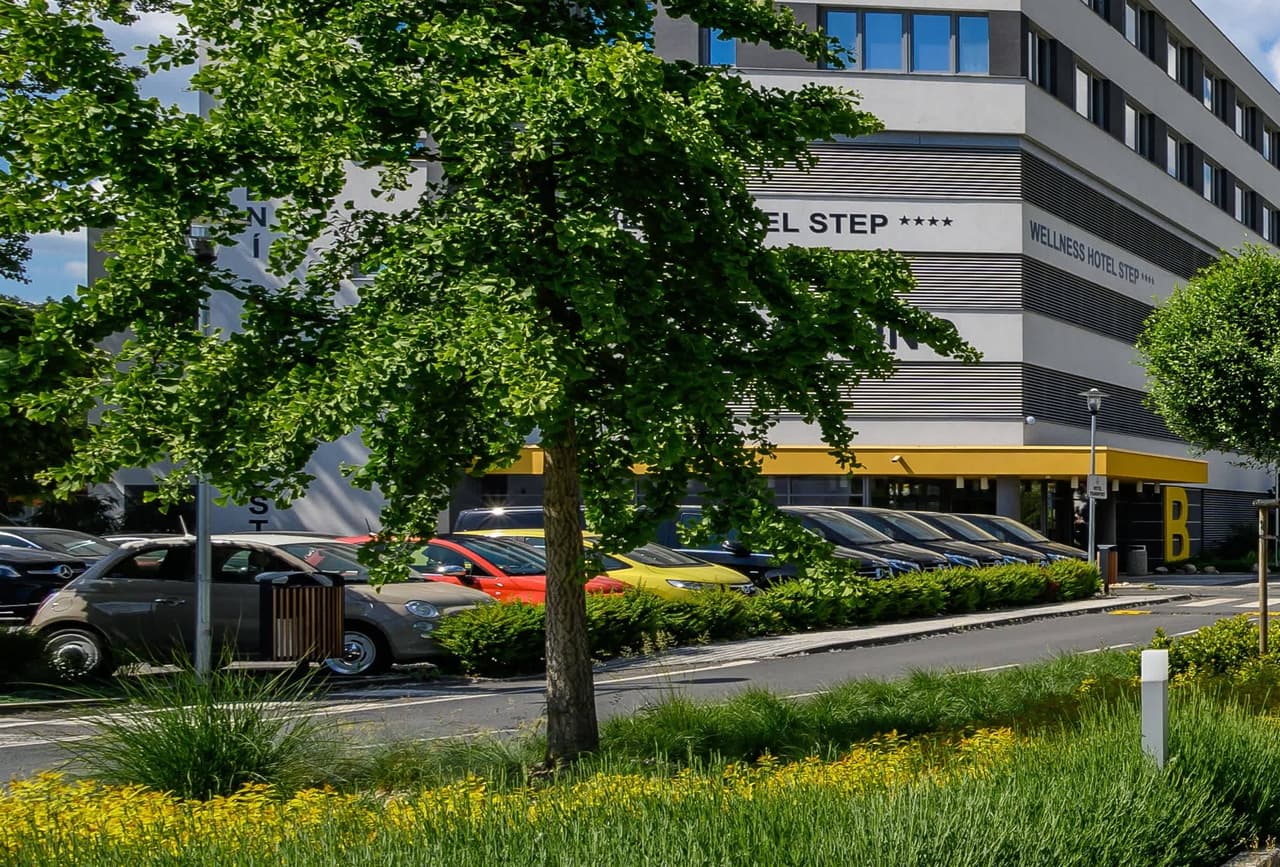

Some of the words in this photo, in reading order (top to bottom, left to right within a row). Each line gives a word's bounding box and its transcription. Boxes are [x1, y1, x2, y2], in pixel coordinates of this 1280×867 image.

[809, 212, 889, 234] STEP
[1030, 220, 1085, 262] WELLNESS
[1087, 246, 1117, 276] HOTEL
[1118, 261, 1140, 285] STEP
[1166, 486, 1190, 562] B
